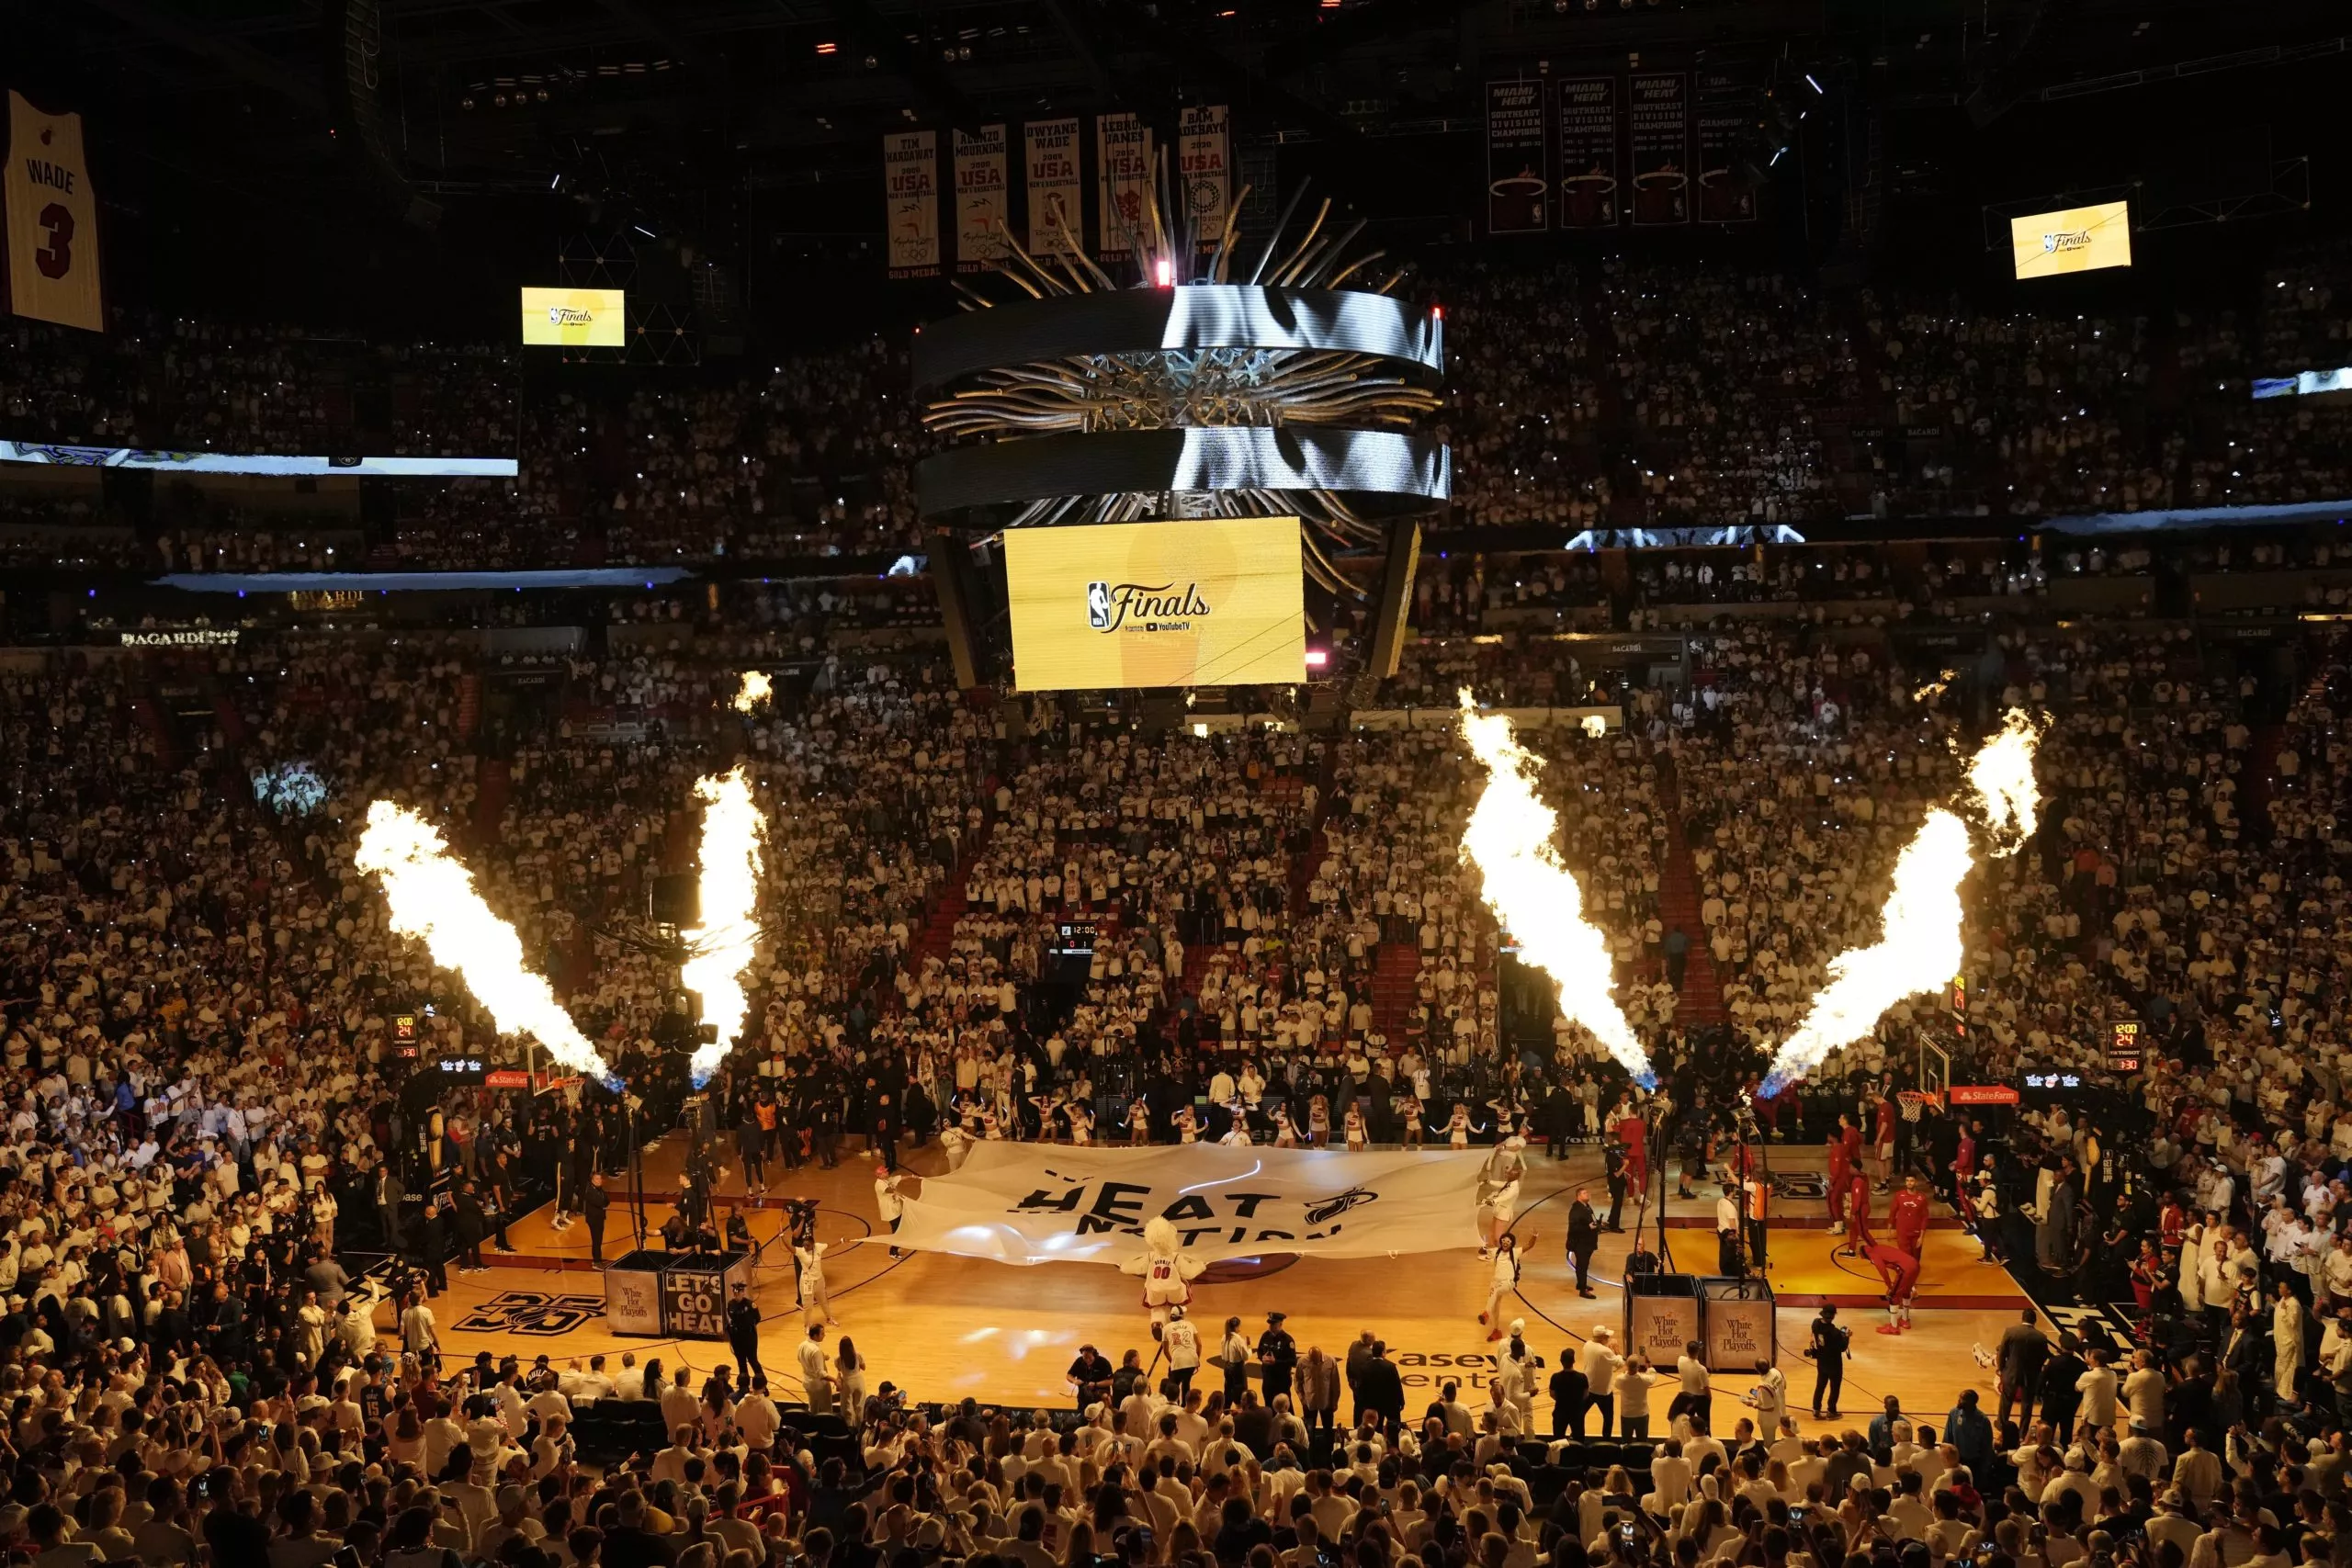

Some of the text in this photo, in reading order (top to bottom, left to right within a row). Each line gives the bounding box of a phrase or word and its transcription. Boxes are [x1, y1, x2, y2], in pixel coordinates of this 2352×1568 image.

[1566, 83, 1605, 94] MIAMI
[1635, 79, 1676, 90] MIAMI
[1493, 87, 1533, 97] MIAMI
[1574, 90, 1610, 103] HEAT
[1644, 86, 1680, 98] HEAT
[1501, 93, 1537, 106] HEAT
[1563, 106, 1611, 115] SOUTHEAST
[1634, 102, 1683, 111] SOUTHEAST
[1187, 111, 1213, 124] BAM
[1491, 108, 1540, 118] SOUTHEAST
[1634, 111, 1683, 120] DIVISION
[1492, 118, 1541, 129] DIVISION
[1563, 115, 1612, 124] DIVISION
[1634, 120, 1683, 130] CHAMPIONS
[1026, 122, 1078, 138] DWYANE
[1492, 128, 1541, 137] CHAMPIONS
[1564, 124, 1612, 134] CHAMPIONS
[900, 138, 919, 151] TIM
[1035, 135, 1070, 149] WADE
[956, 141, 1004, 157] MOURNING
[887, 149, 933, 163] HARDAWAY
[1181, 153, 1223, 172] USA
[1033, 161, 1073, 179] USA
[26, 158, 74, 195] WADE
[960, 168, 1001, 186] USA
[892, 174, 930, 192] USA
[36, 202, 74, 279] 3
[2051, 231, 2092, 254] Finals
[888, 269, 910, 279] GOLD
[557, 309, 594, 326] Finals
[1101, 581, 1211, 634] Finals
[1073, 926, 1095, 934] 12:00
[1069, 940, 1075, 948] 0
[397, 1017, 413, 1026] 12:00
[398, 1026, 411, 1037] 24
[2116, 1024, 2137, 1033] 12:00
[2116, 1034, 2133, 1046] 24
[2103, 1159, 2113, 1168] GET
[2103, 1175, 2113, 1183] APP
[1153, 1266, 1171, 1280] 00
[666, 1273, 721, 1295] LET'S
[621, 1286, 643, 1299] White
[627, 1295, 640, 1306] Hot
[678, 1293, 713, 1314] GO
[620, 1305, 648, 1317] Playoffs
[669, 1312, 724, 1336] HEAT
[1652, 1314, 1679, 1327] White
[1725, 1319, 1753, 1331] White
[1657, 1326, 1673, 1337] Hot
[1731, 1329, 1747, 1340] Hot
[1649, 1336, 1682, 1348] Playoffs
[1723, 1339, 1758, 1353] Playoffs
